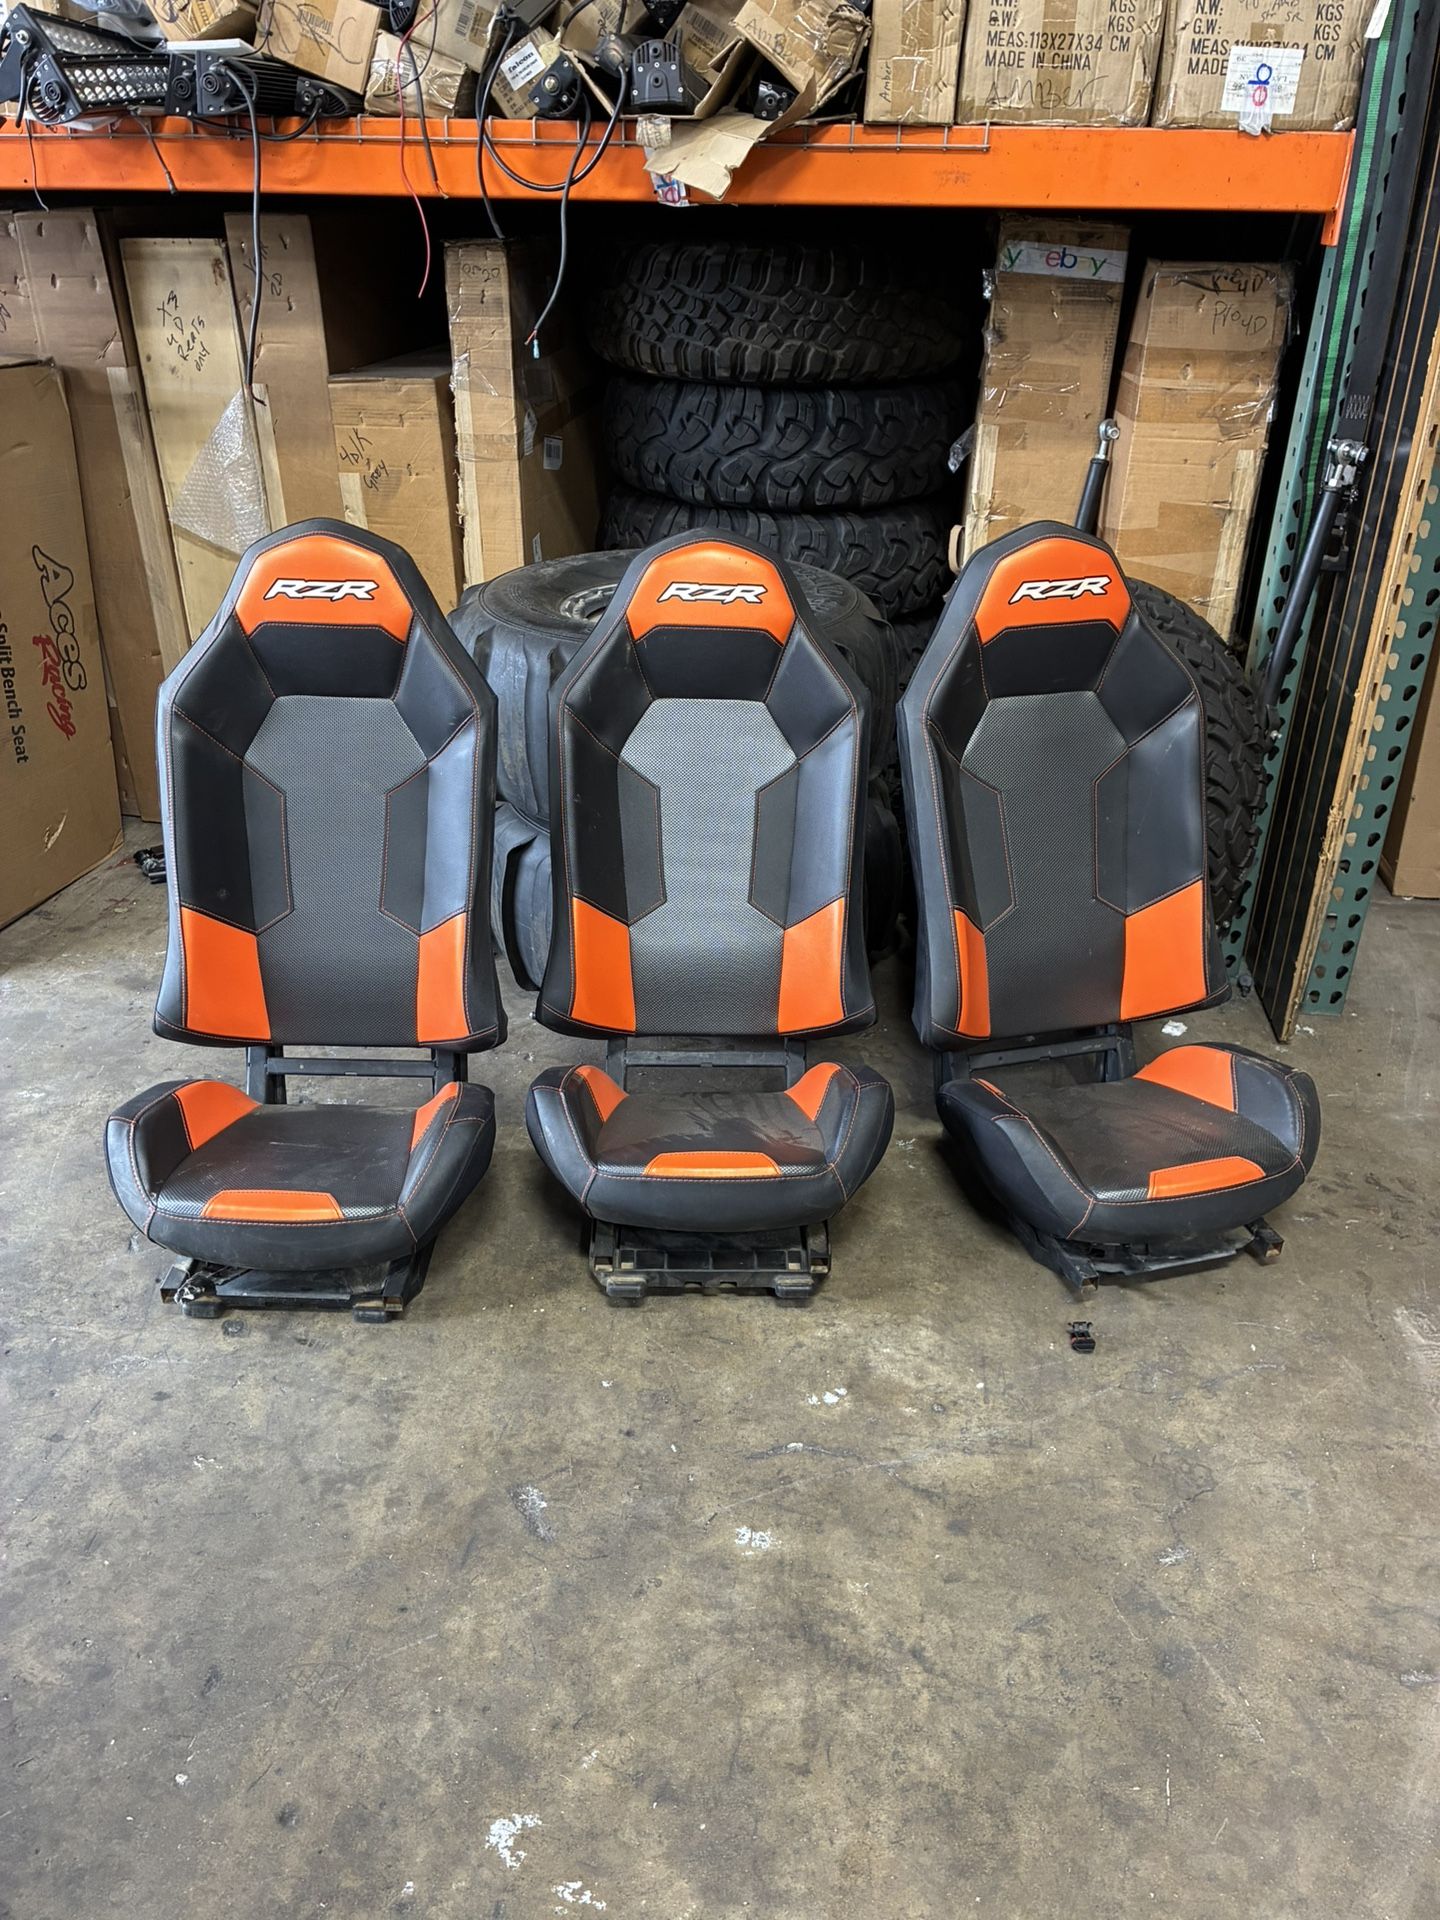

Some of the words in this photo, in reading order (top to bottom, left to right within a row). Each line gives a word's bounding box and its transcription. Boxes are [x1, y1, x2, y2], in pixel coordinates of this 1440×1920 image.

[1107, 15, 1136, 33] KGS
[1315, 3, 1345, 22] KGS
[1192, 18, 1222, 35] G.W:
[1313, 24, 1342, 42] KGS
[1109, 35, 1131, 52] CM
[1315, 43, 1336, 61] CM
[985, 50, 1026, 69] MADE
[1031, 52, 1046, 69] IN
[1051, 53, 1091, 70] CHINA
[1187, 57, 1229, 76] MADE
[1045, 247, 1108, 276] eby
[263, 578, 381, 602] RZR
[656, 581, 769, 605] RZR
[1008, 575, 1112, 605] RZR
[31, 544, 88, 692] Aces
[32, 633, 77, 742] Racing
[1, 667, 23, 719] Bench
[12, 724, 29, 764] Seat
